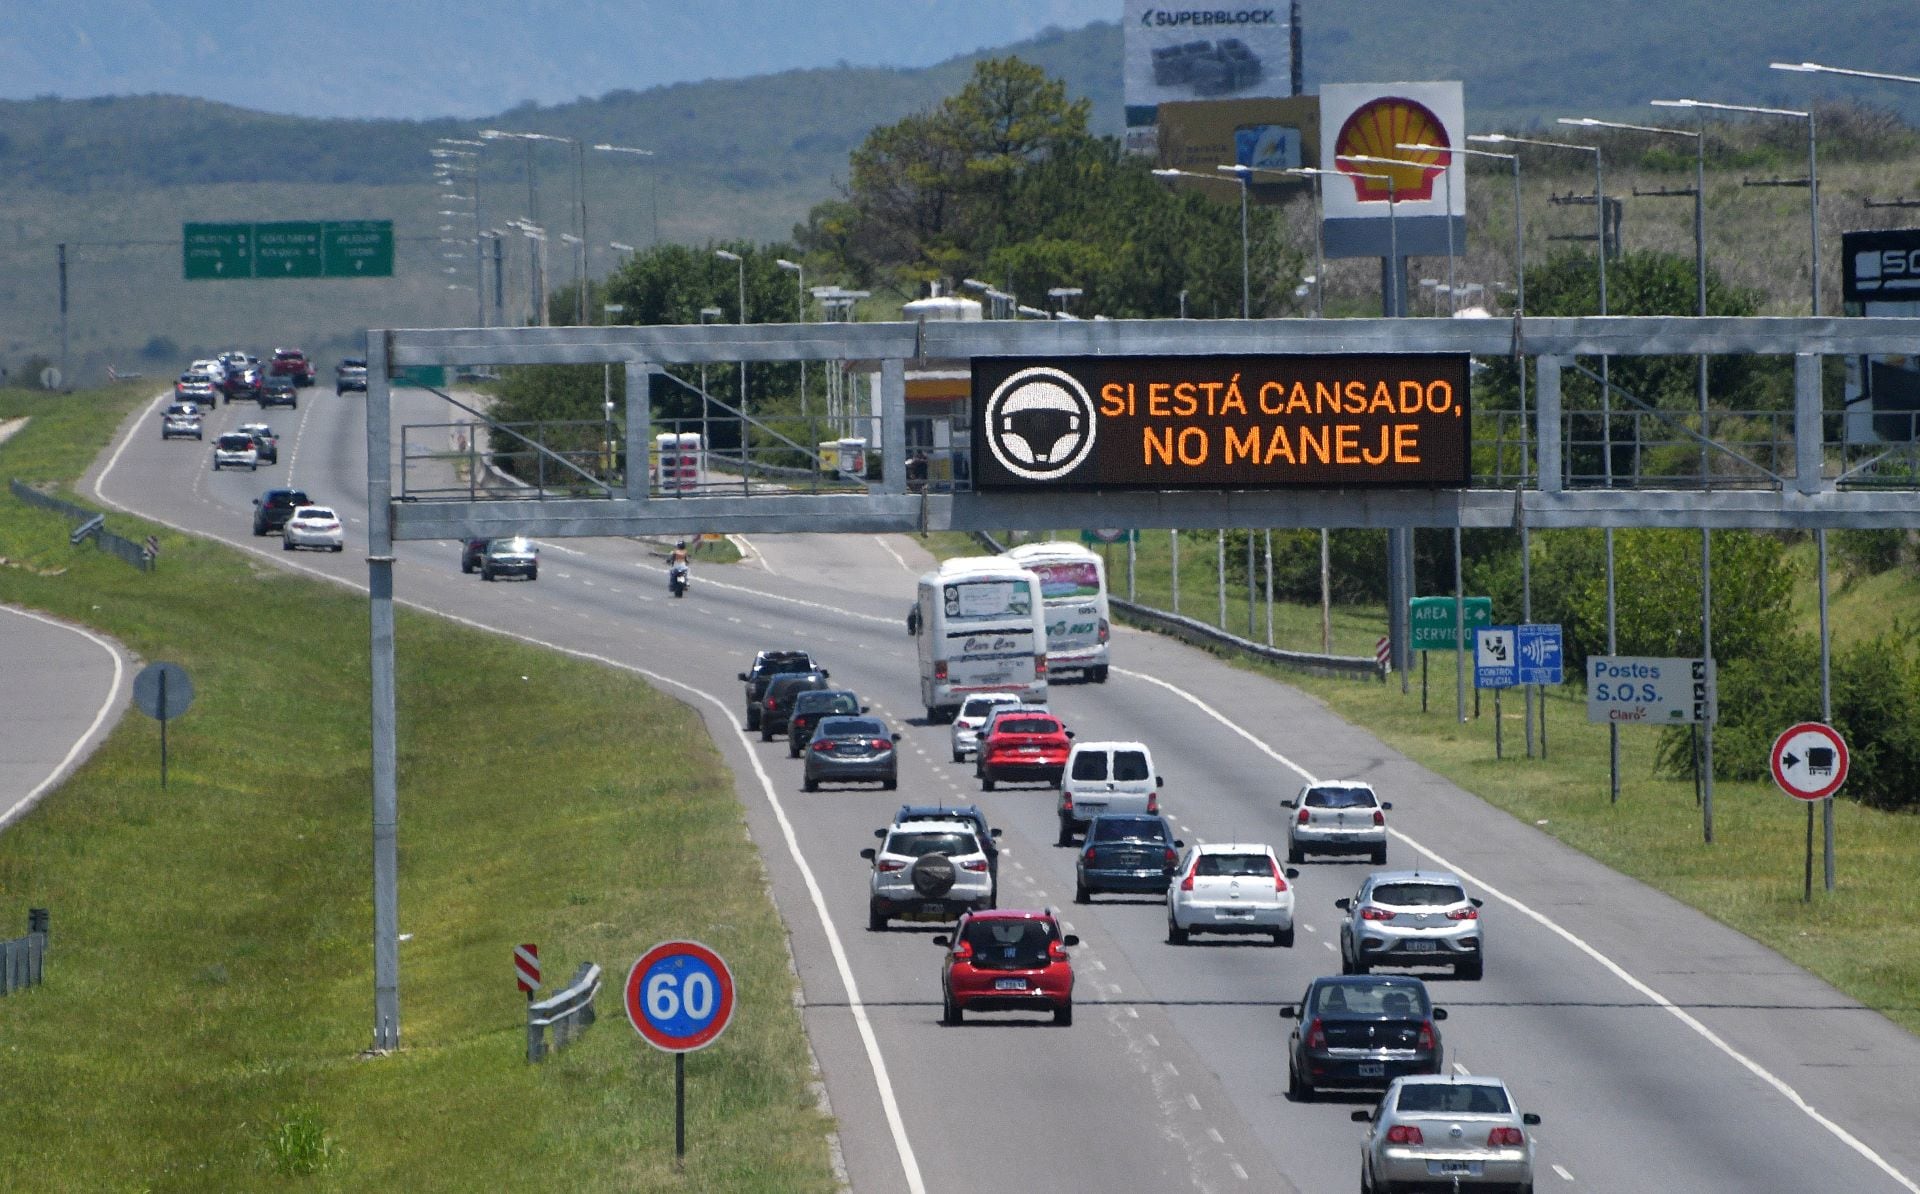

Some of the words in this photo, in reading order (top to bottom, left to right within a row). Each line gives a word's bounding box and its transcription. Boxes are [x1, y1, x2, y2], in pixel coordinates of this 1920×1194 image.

[1156, 10, 1273, 26] SUPERBLOCK
[1100, 384, 1136, 416] SI
[1149, 374, 1247, 417] ESTÁ
[1260, 380, 1462, 418] CANSADO,
[1143, 427, 1208, 465] NO
[1225, 424, 1421, 465] MANEJE
[1416, 607, 1448, 620] AREA
[1416, 627, 1472, 641] SERVICO
[1595, 662, 1661, 679] Postes
[1596, 684, 1663, 702] S.O.S.
[1610, 709, 1640, 720] Claro
[647, 972, 713, 1020] 60
